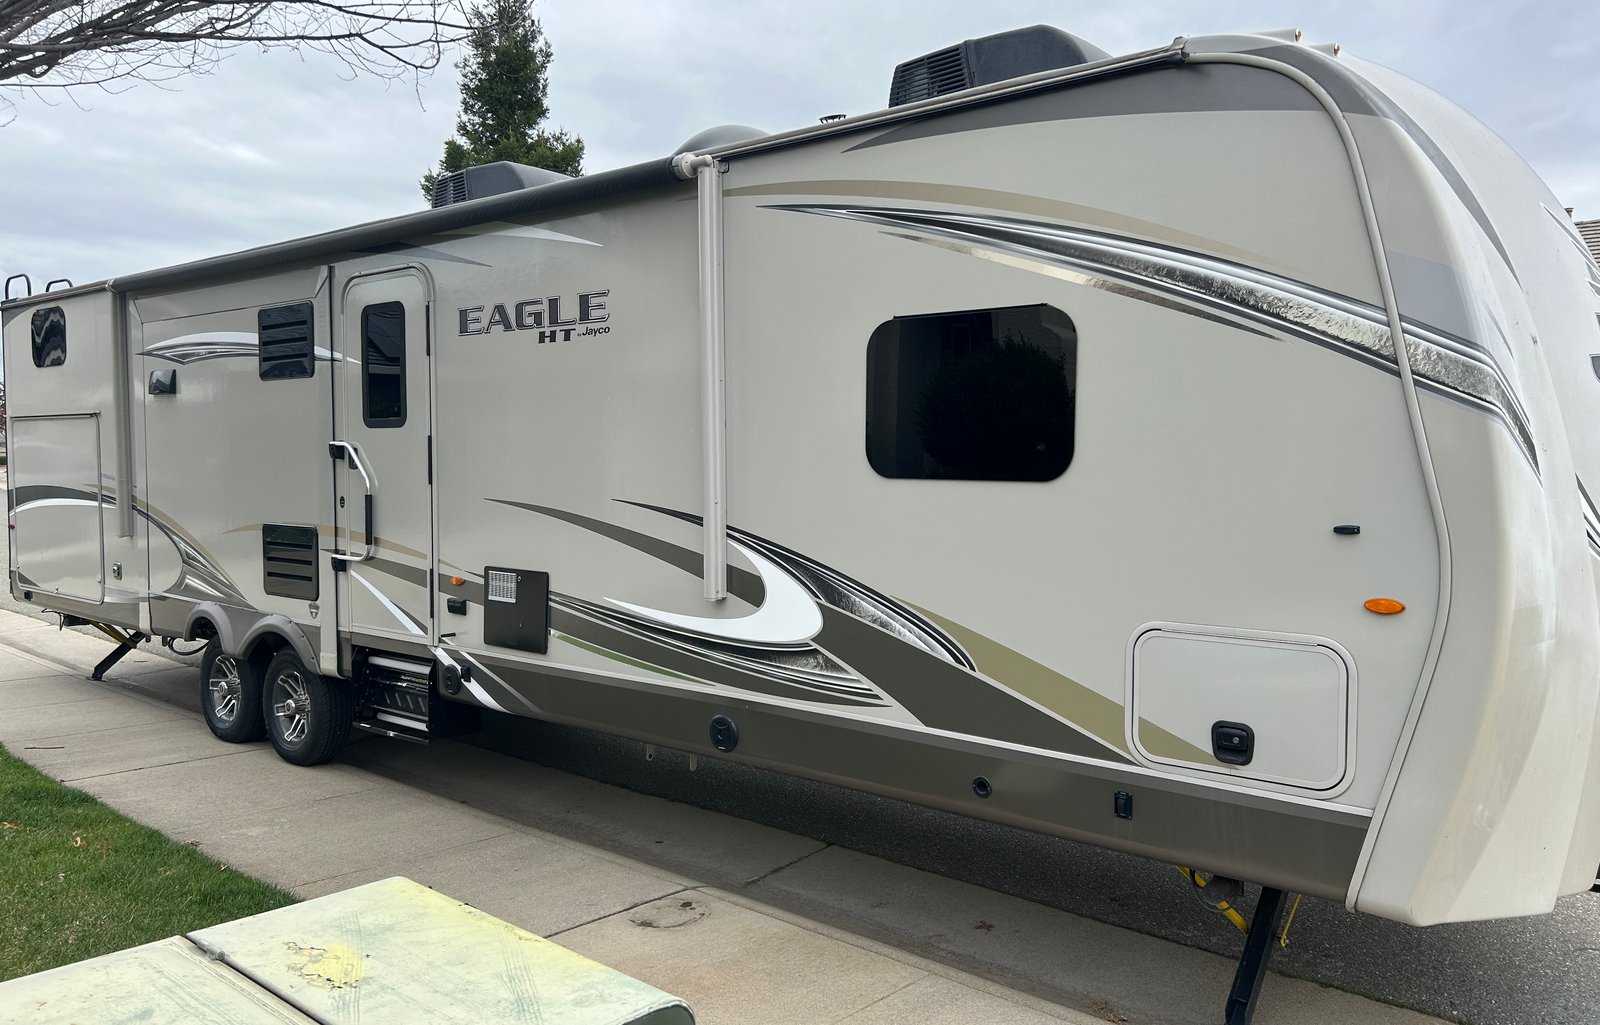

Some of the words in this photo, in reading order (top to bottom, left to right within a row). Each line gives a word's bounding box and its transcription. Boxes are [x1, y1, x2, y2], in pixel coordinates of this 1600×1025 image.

[458, 289, 610, 336] EAGLE
[538, 328, 576, 344] HT
[582, 326, 611, 337] Jayco
